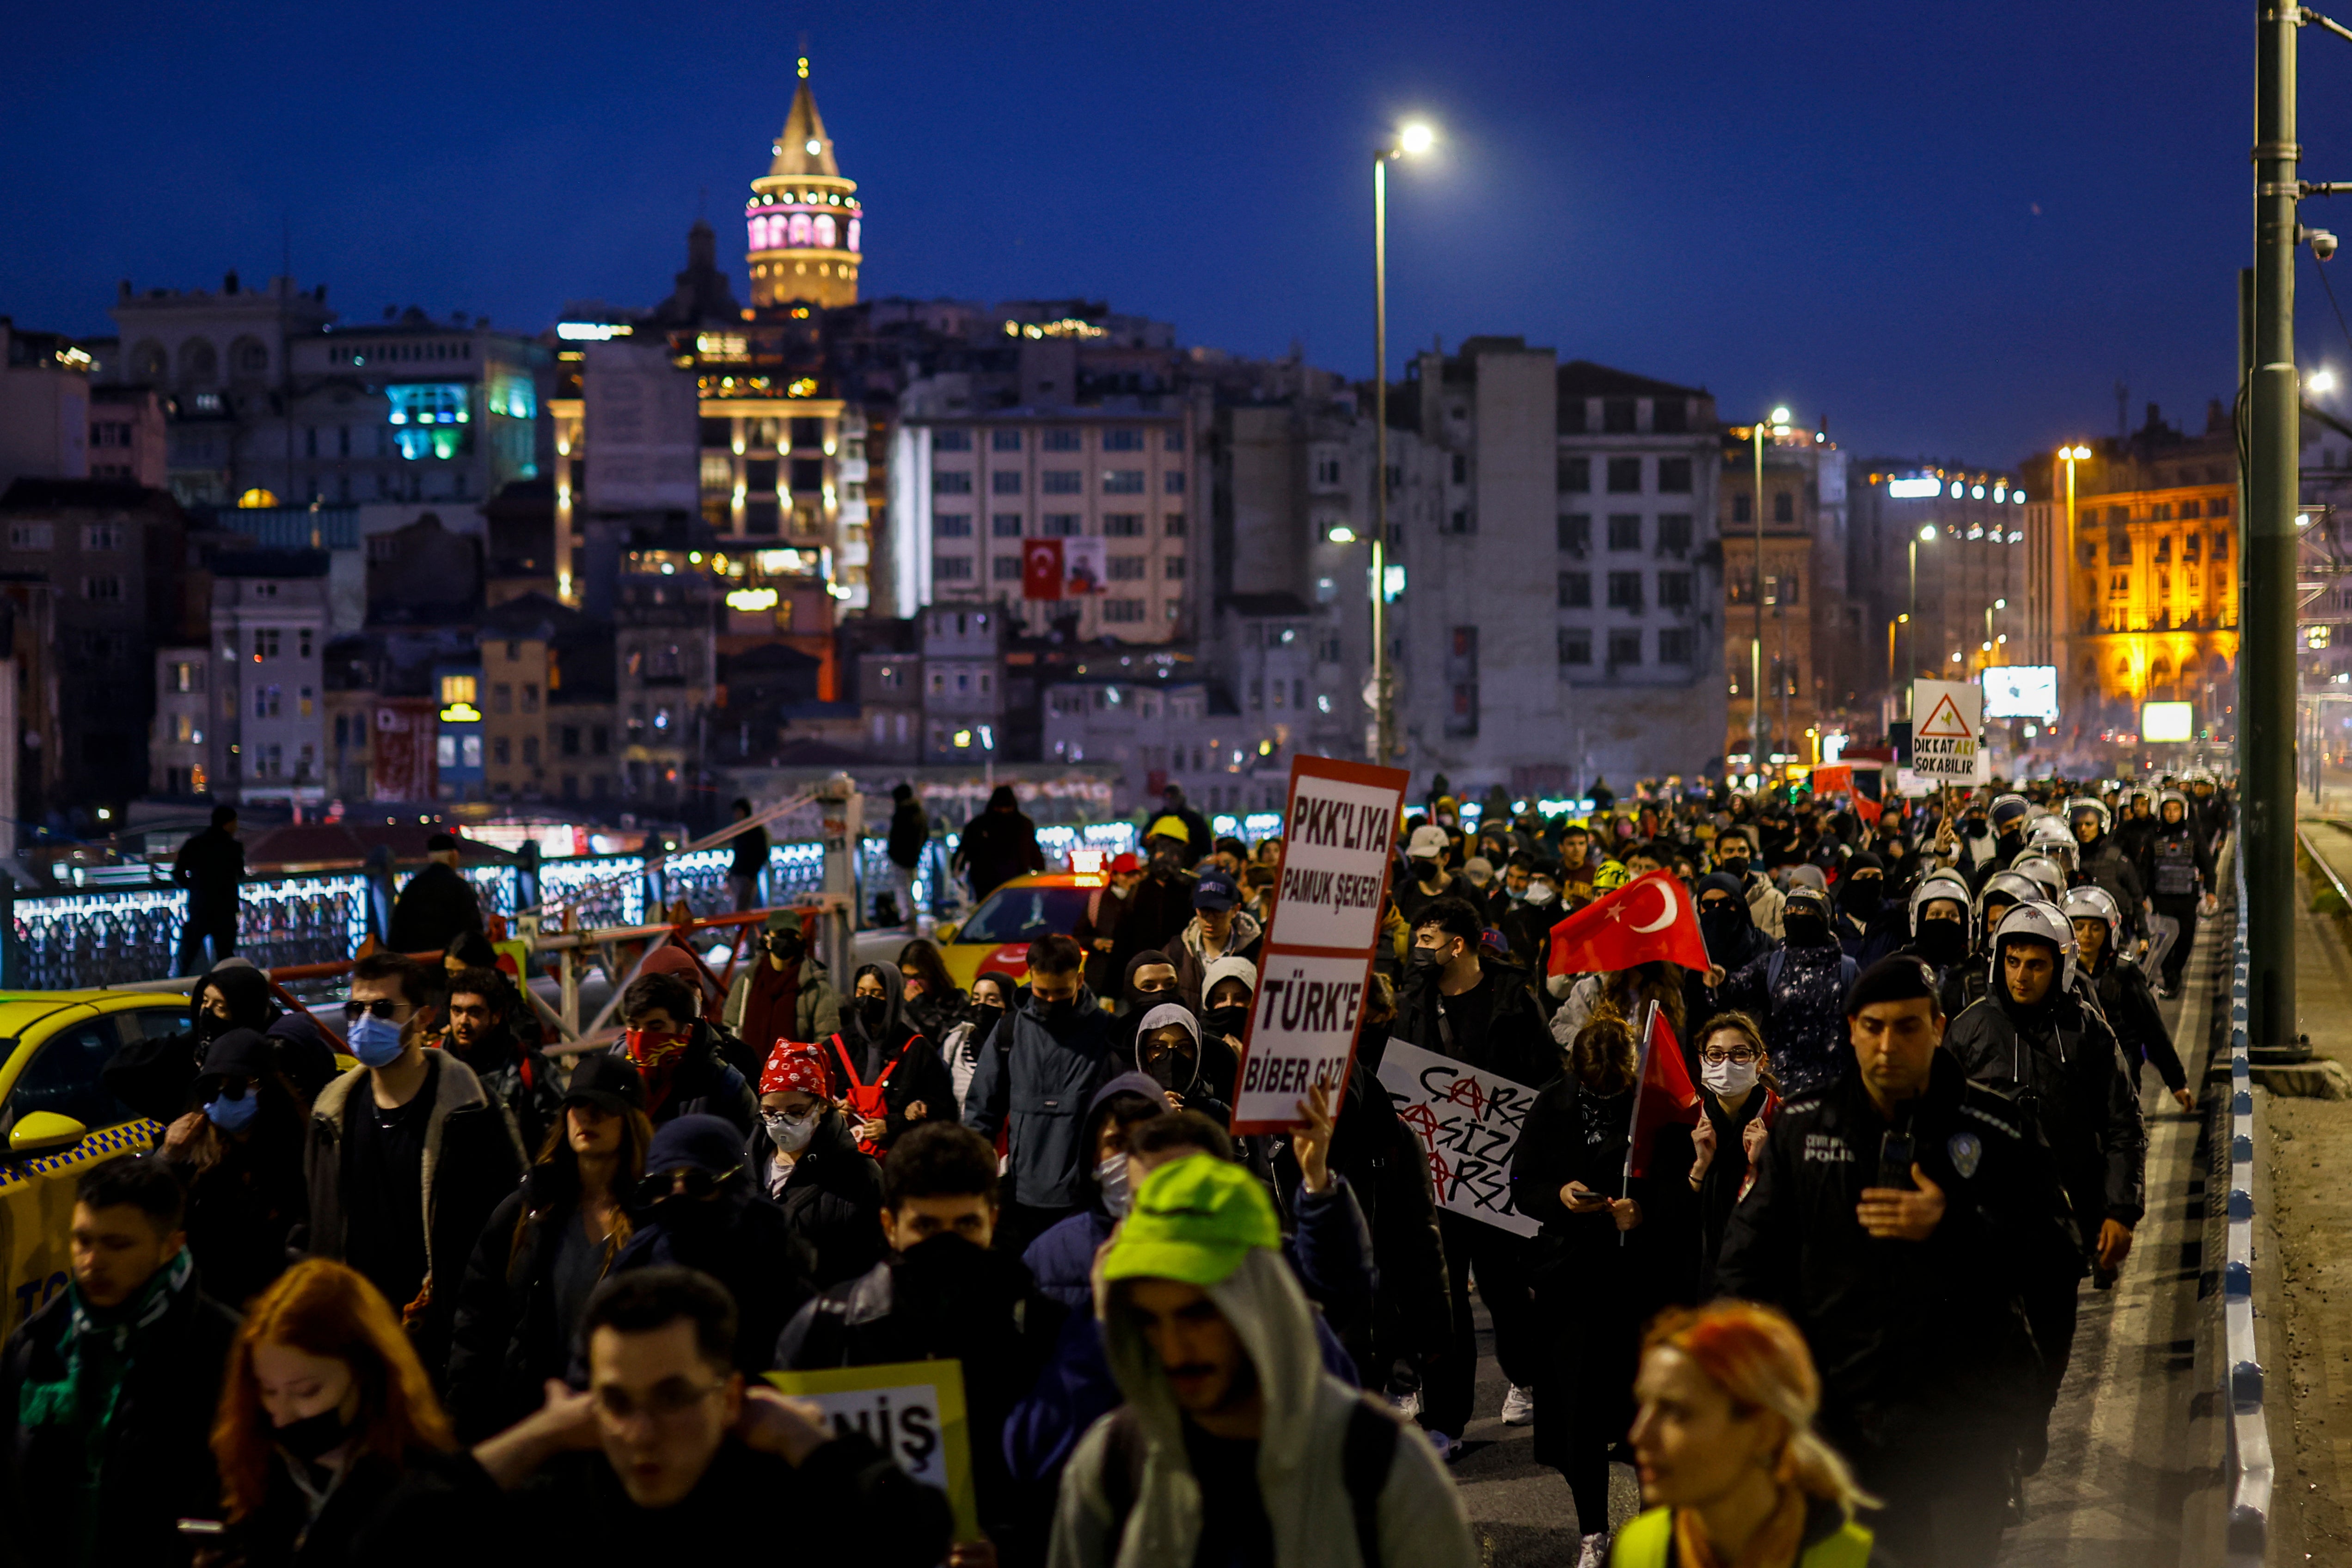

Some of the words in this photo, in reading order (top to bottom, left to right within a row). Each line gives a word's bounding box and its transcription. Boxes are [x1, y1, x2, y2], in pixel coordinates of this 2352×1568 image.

[1914, 737, 1955, 754] DIKKAT
[1915, 757, 1973, 775] SOKABILIR
[1291, 795, 1389, 853] PKK'LIYA
[1280, 867, 1335, 905] PAMUK
[1334, 869, 1383, 915] ŞEKERİ
[1262, 969, 1362, 1032] TÜRK'E
[1243, 1048, 1311, 1093] BİBER
